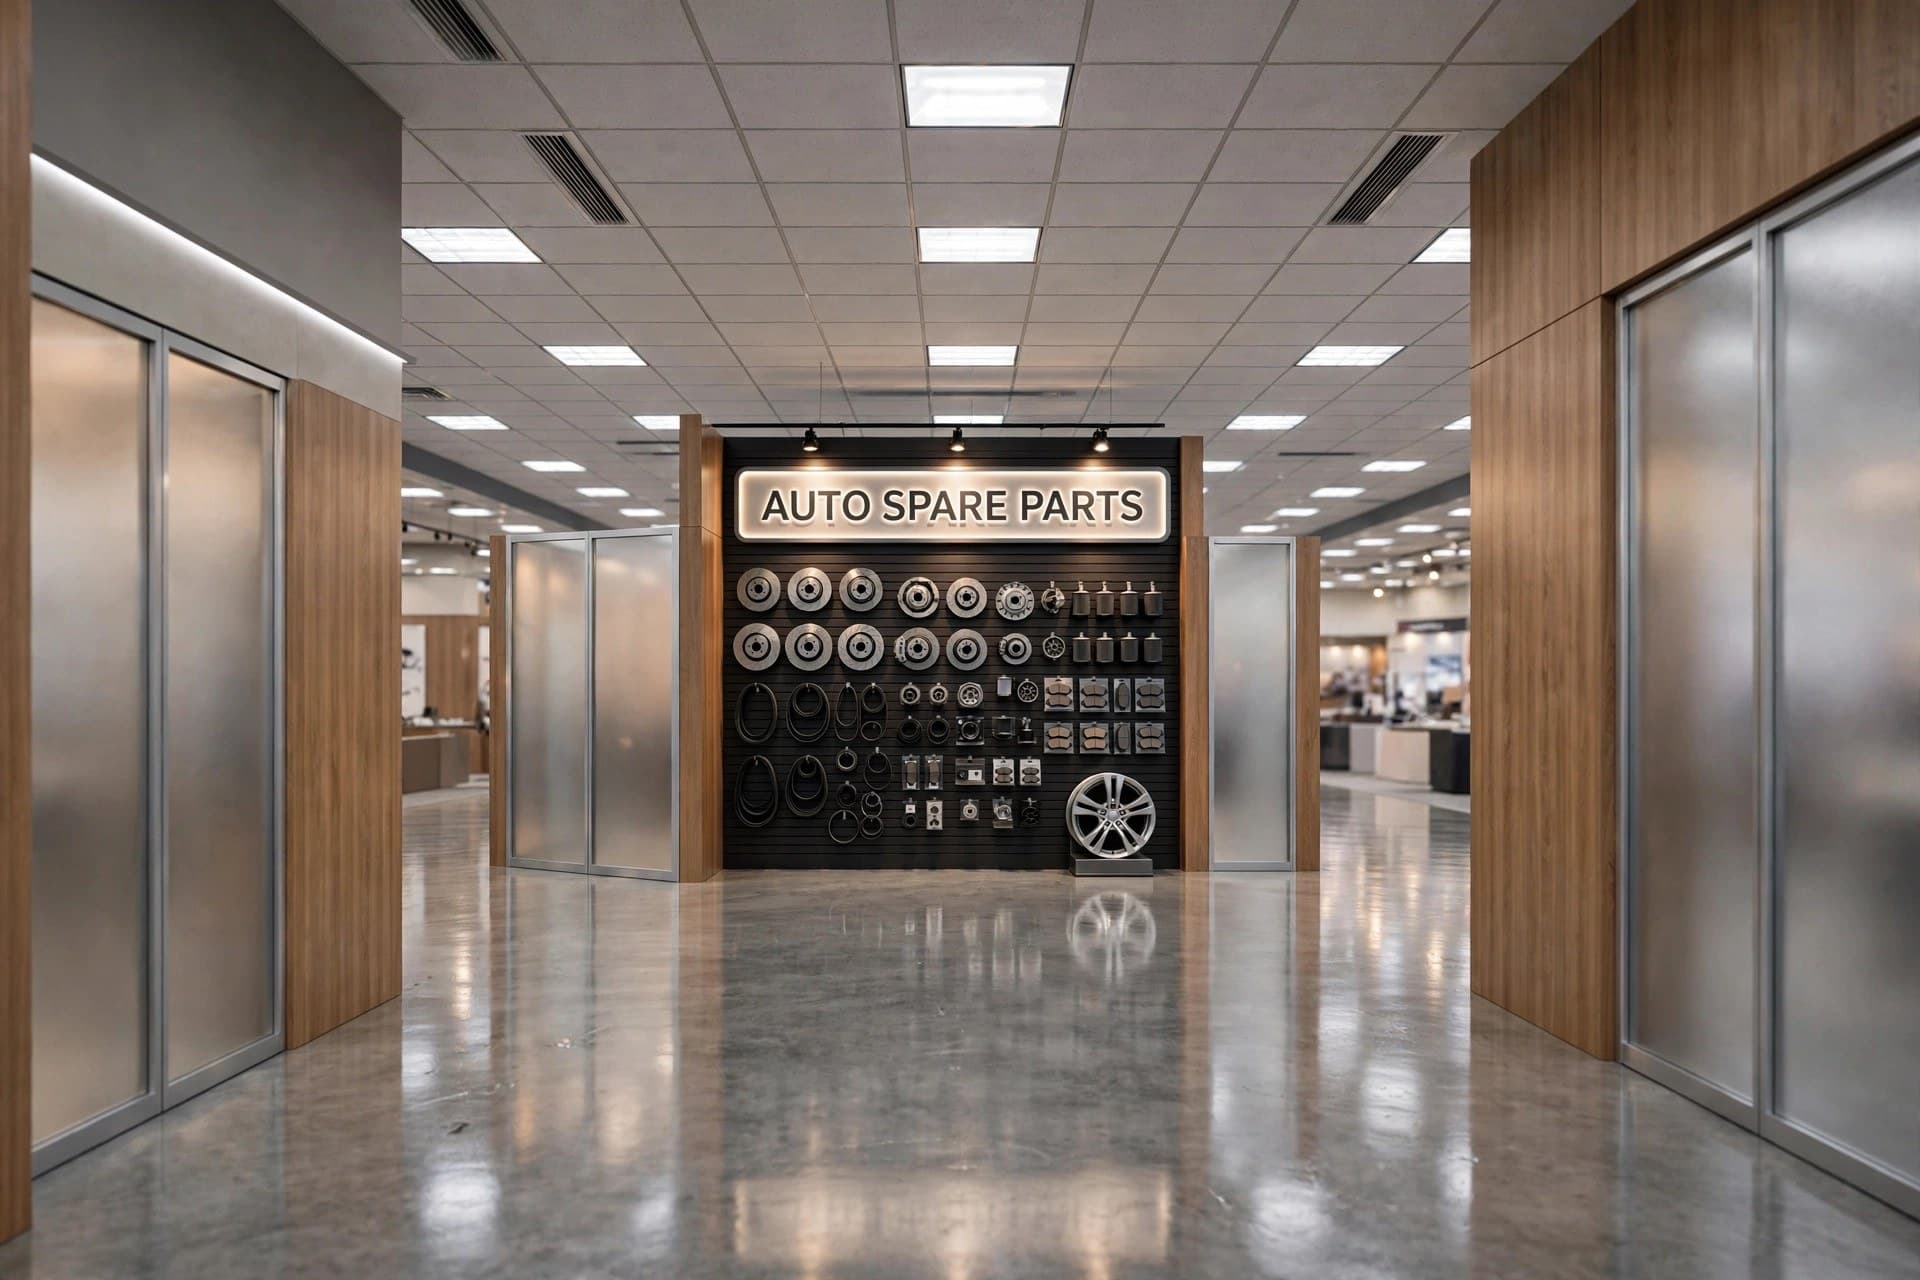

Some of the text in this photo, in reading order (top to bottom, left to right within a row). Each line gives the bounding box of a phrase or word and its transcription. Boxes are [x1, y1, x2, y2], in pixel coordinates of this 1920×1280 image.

[761, 490, 1143, 521] AUTO SPARE PARTS
